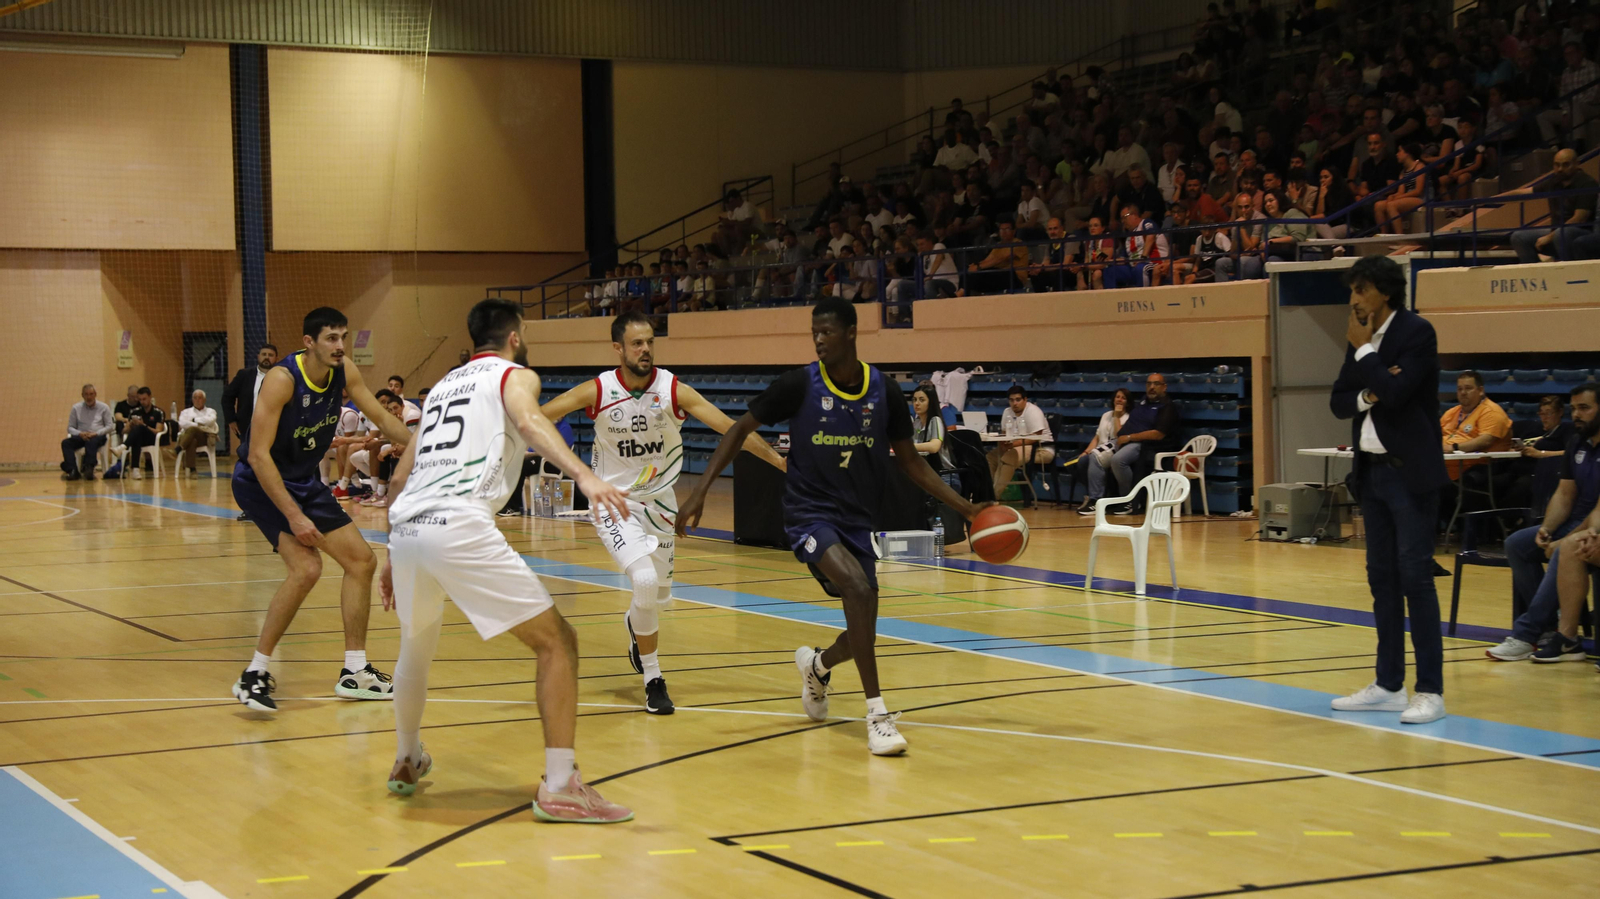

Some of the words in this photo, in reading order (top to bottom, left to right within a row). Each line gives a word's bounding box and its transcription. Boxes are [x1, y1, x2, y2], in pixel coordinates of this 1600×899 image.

[1490, 278, 1548, 294] PRENSA
[1117, 300, 1155, 313] PRENSA
[1191, 296, 1206, 309] TV
[418, 398, 471, 456] 25
[607, 426, 628, 434] alsa
[631, 414, 648, 433] 88
[838, 450, 853, 469] 7
